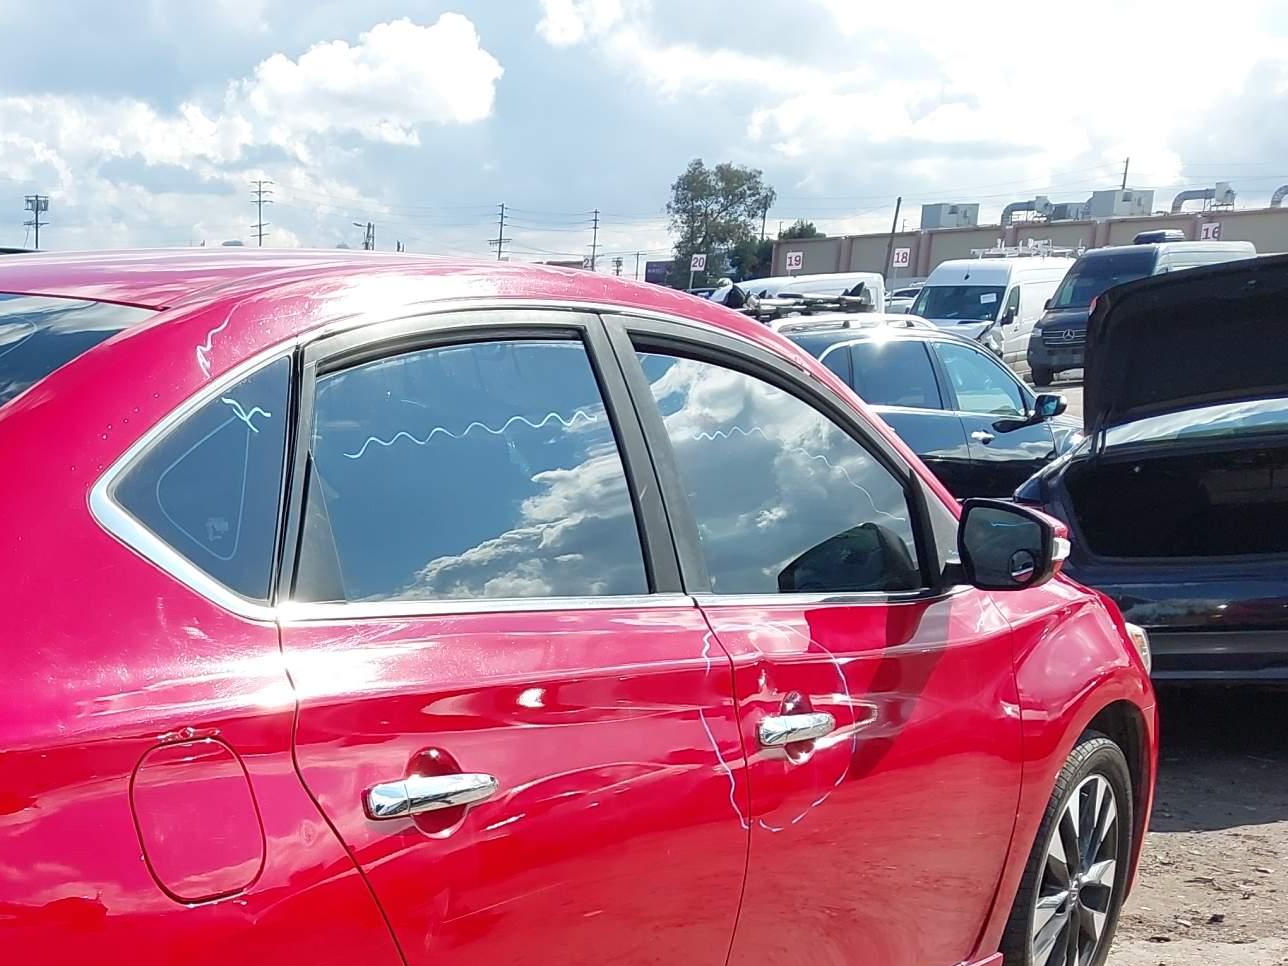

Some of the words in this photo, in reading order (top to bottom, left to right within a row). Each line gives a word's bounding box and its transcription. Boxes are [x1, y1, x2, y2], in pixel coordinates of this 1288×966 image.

[691, 256, 705, 268] 20
[787, 254, 802, 267] 19
[894, 251, 909, 264] 18
